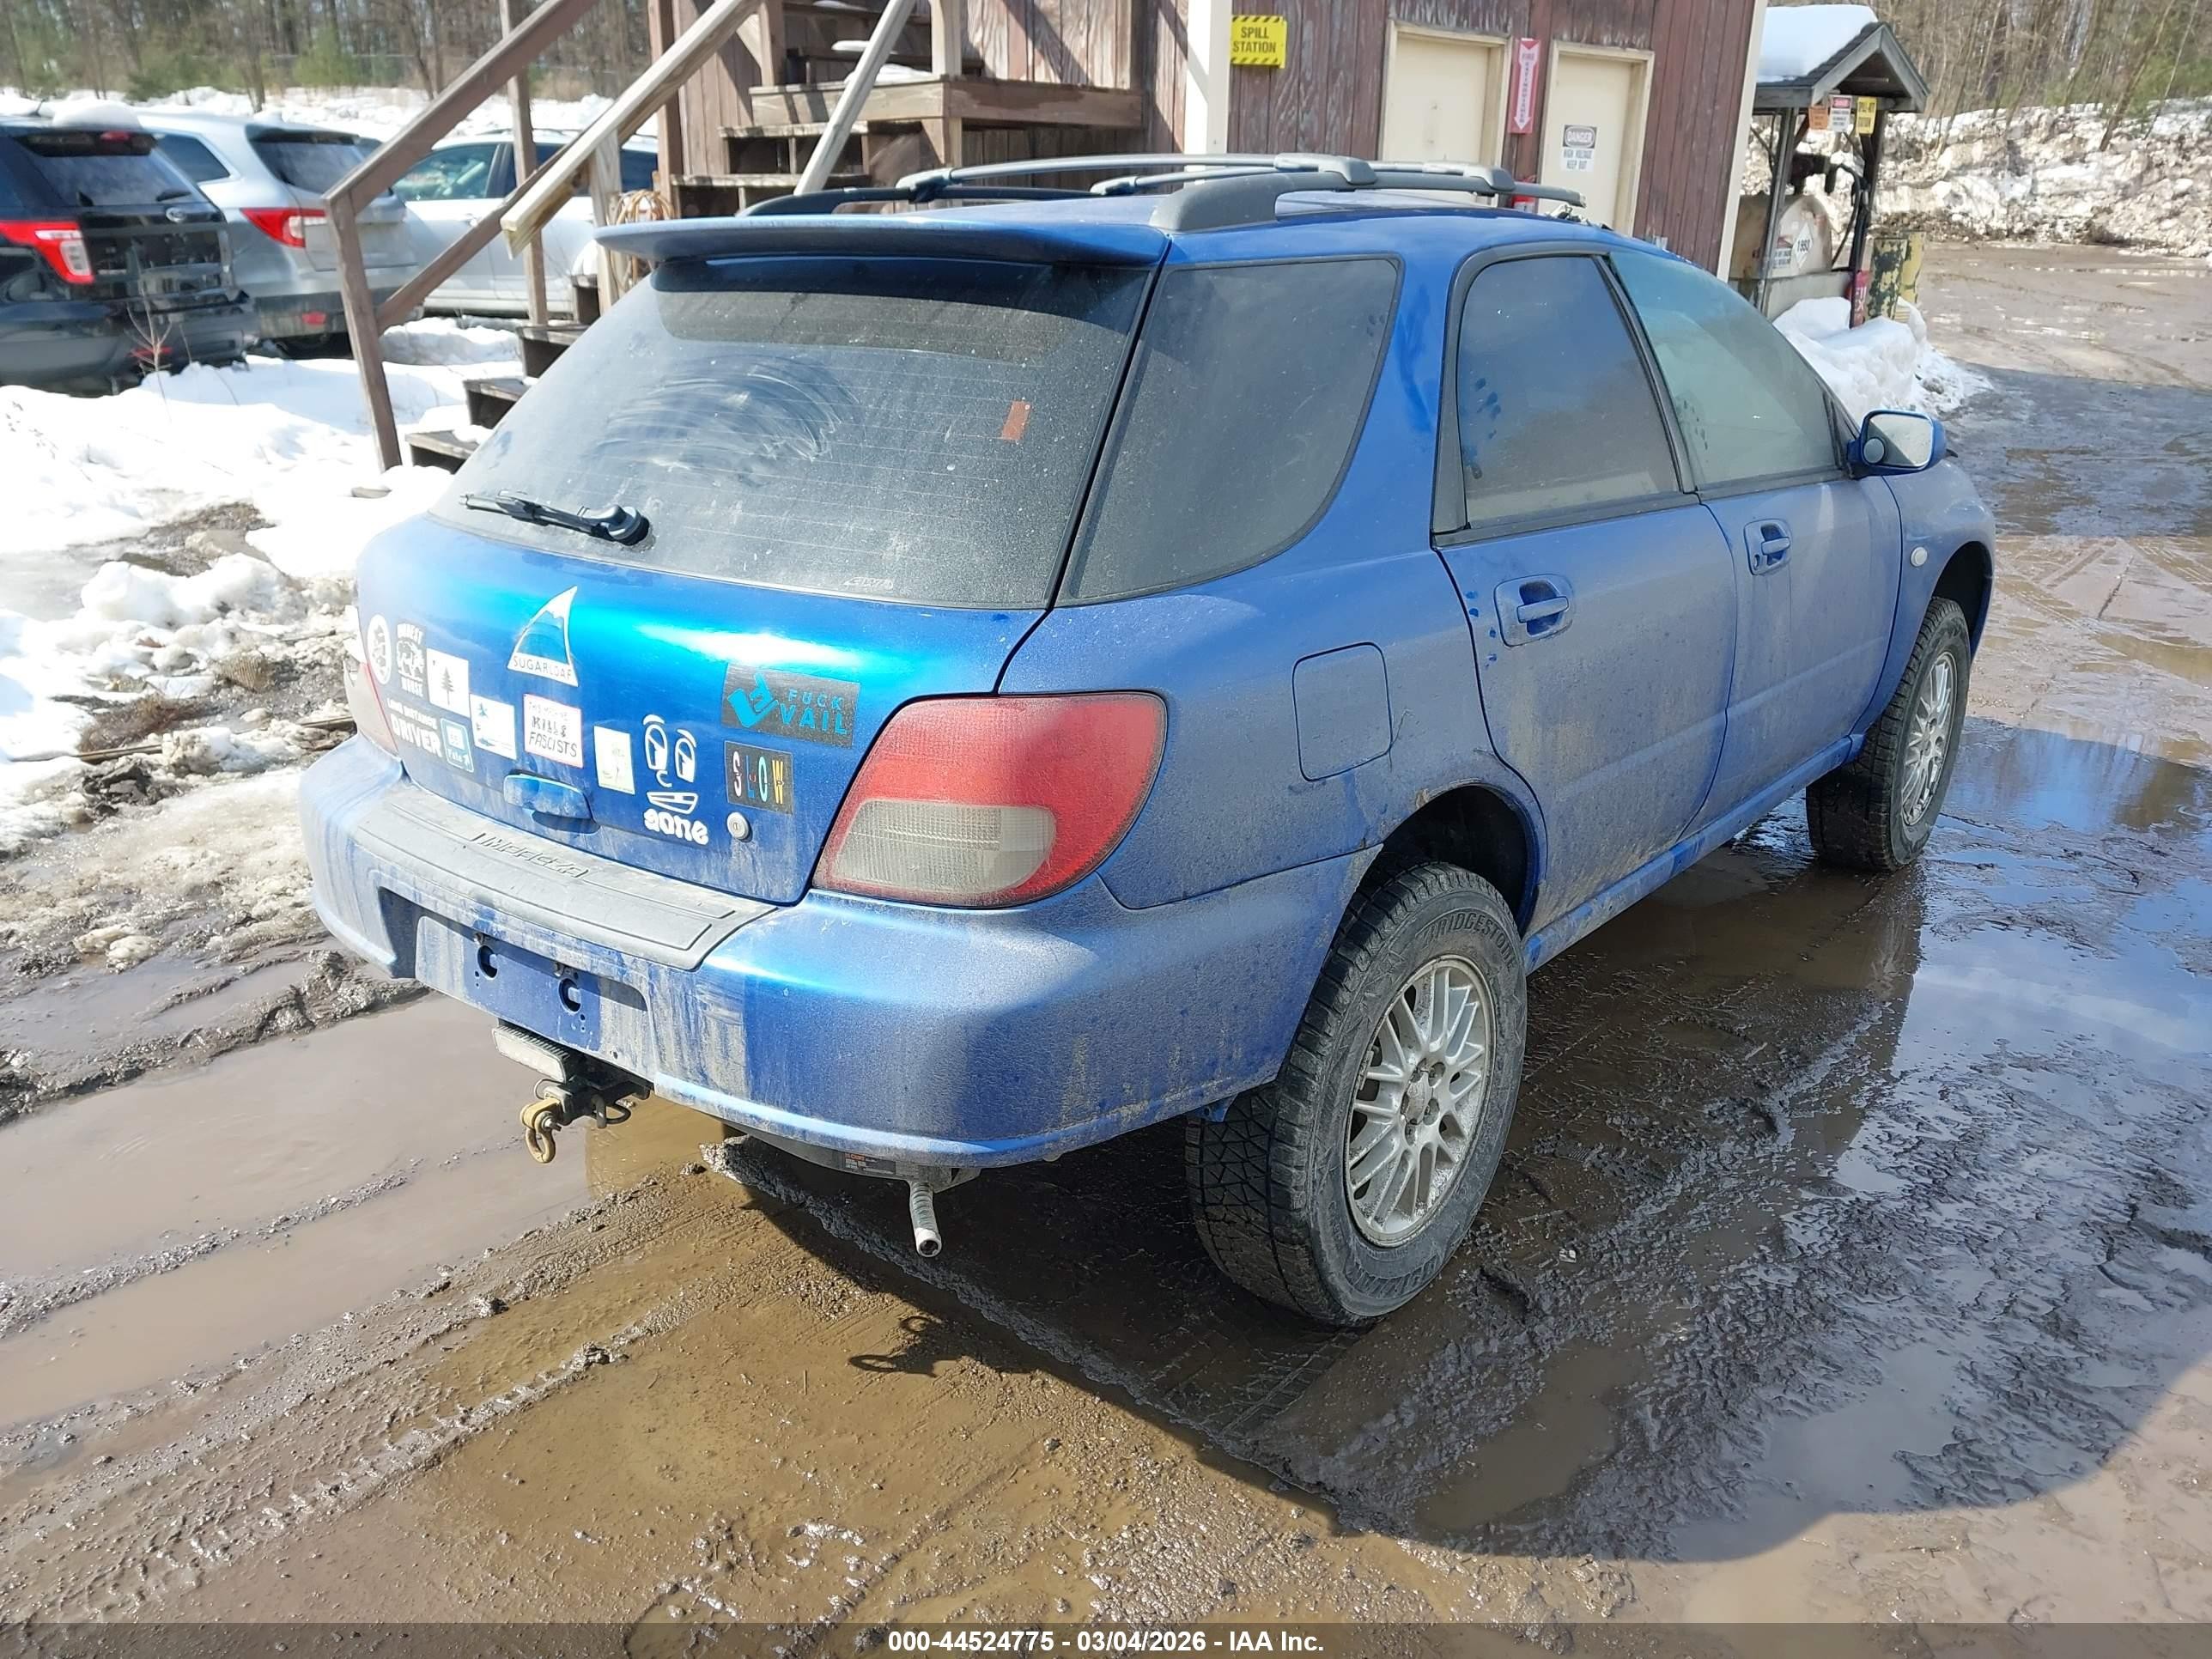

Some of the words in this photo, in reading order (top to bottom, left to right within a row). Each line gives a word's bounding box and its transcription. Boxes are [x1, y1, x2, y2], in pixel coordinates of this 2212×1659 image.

[1241, 27, 1270, 39] SPILL
[1232, 40, 1277, 53] STATION
[514, 655, 572, 680] SUGARLOAF
[787, 689, 844, 711] FUCK
[532, 715, 567, 738] KILLS
[779, 703, 848, 735] VAIL
[390, 713, 443, 757] DRIVER
[528, 732, 578, 758] FASCISTS
[732, 750, 784, 805] SLOW
